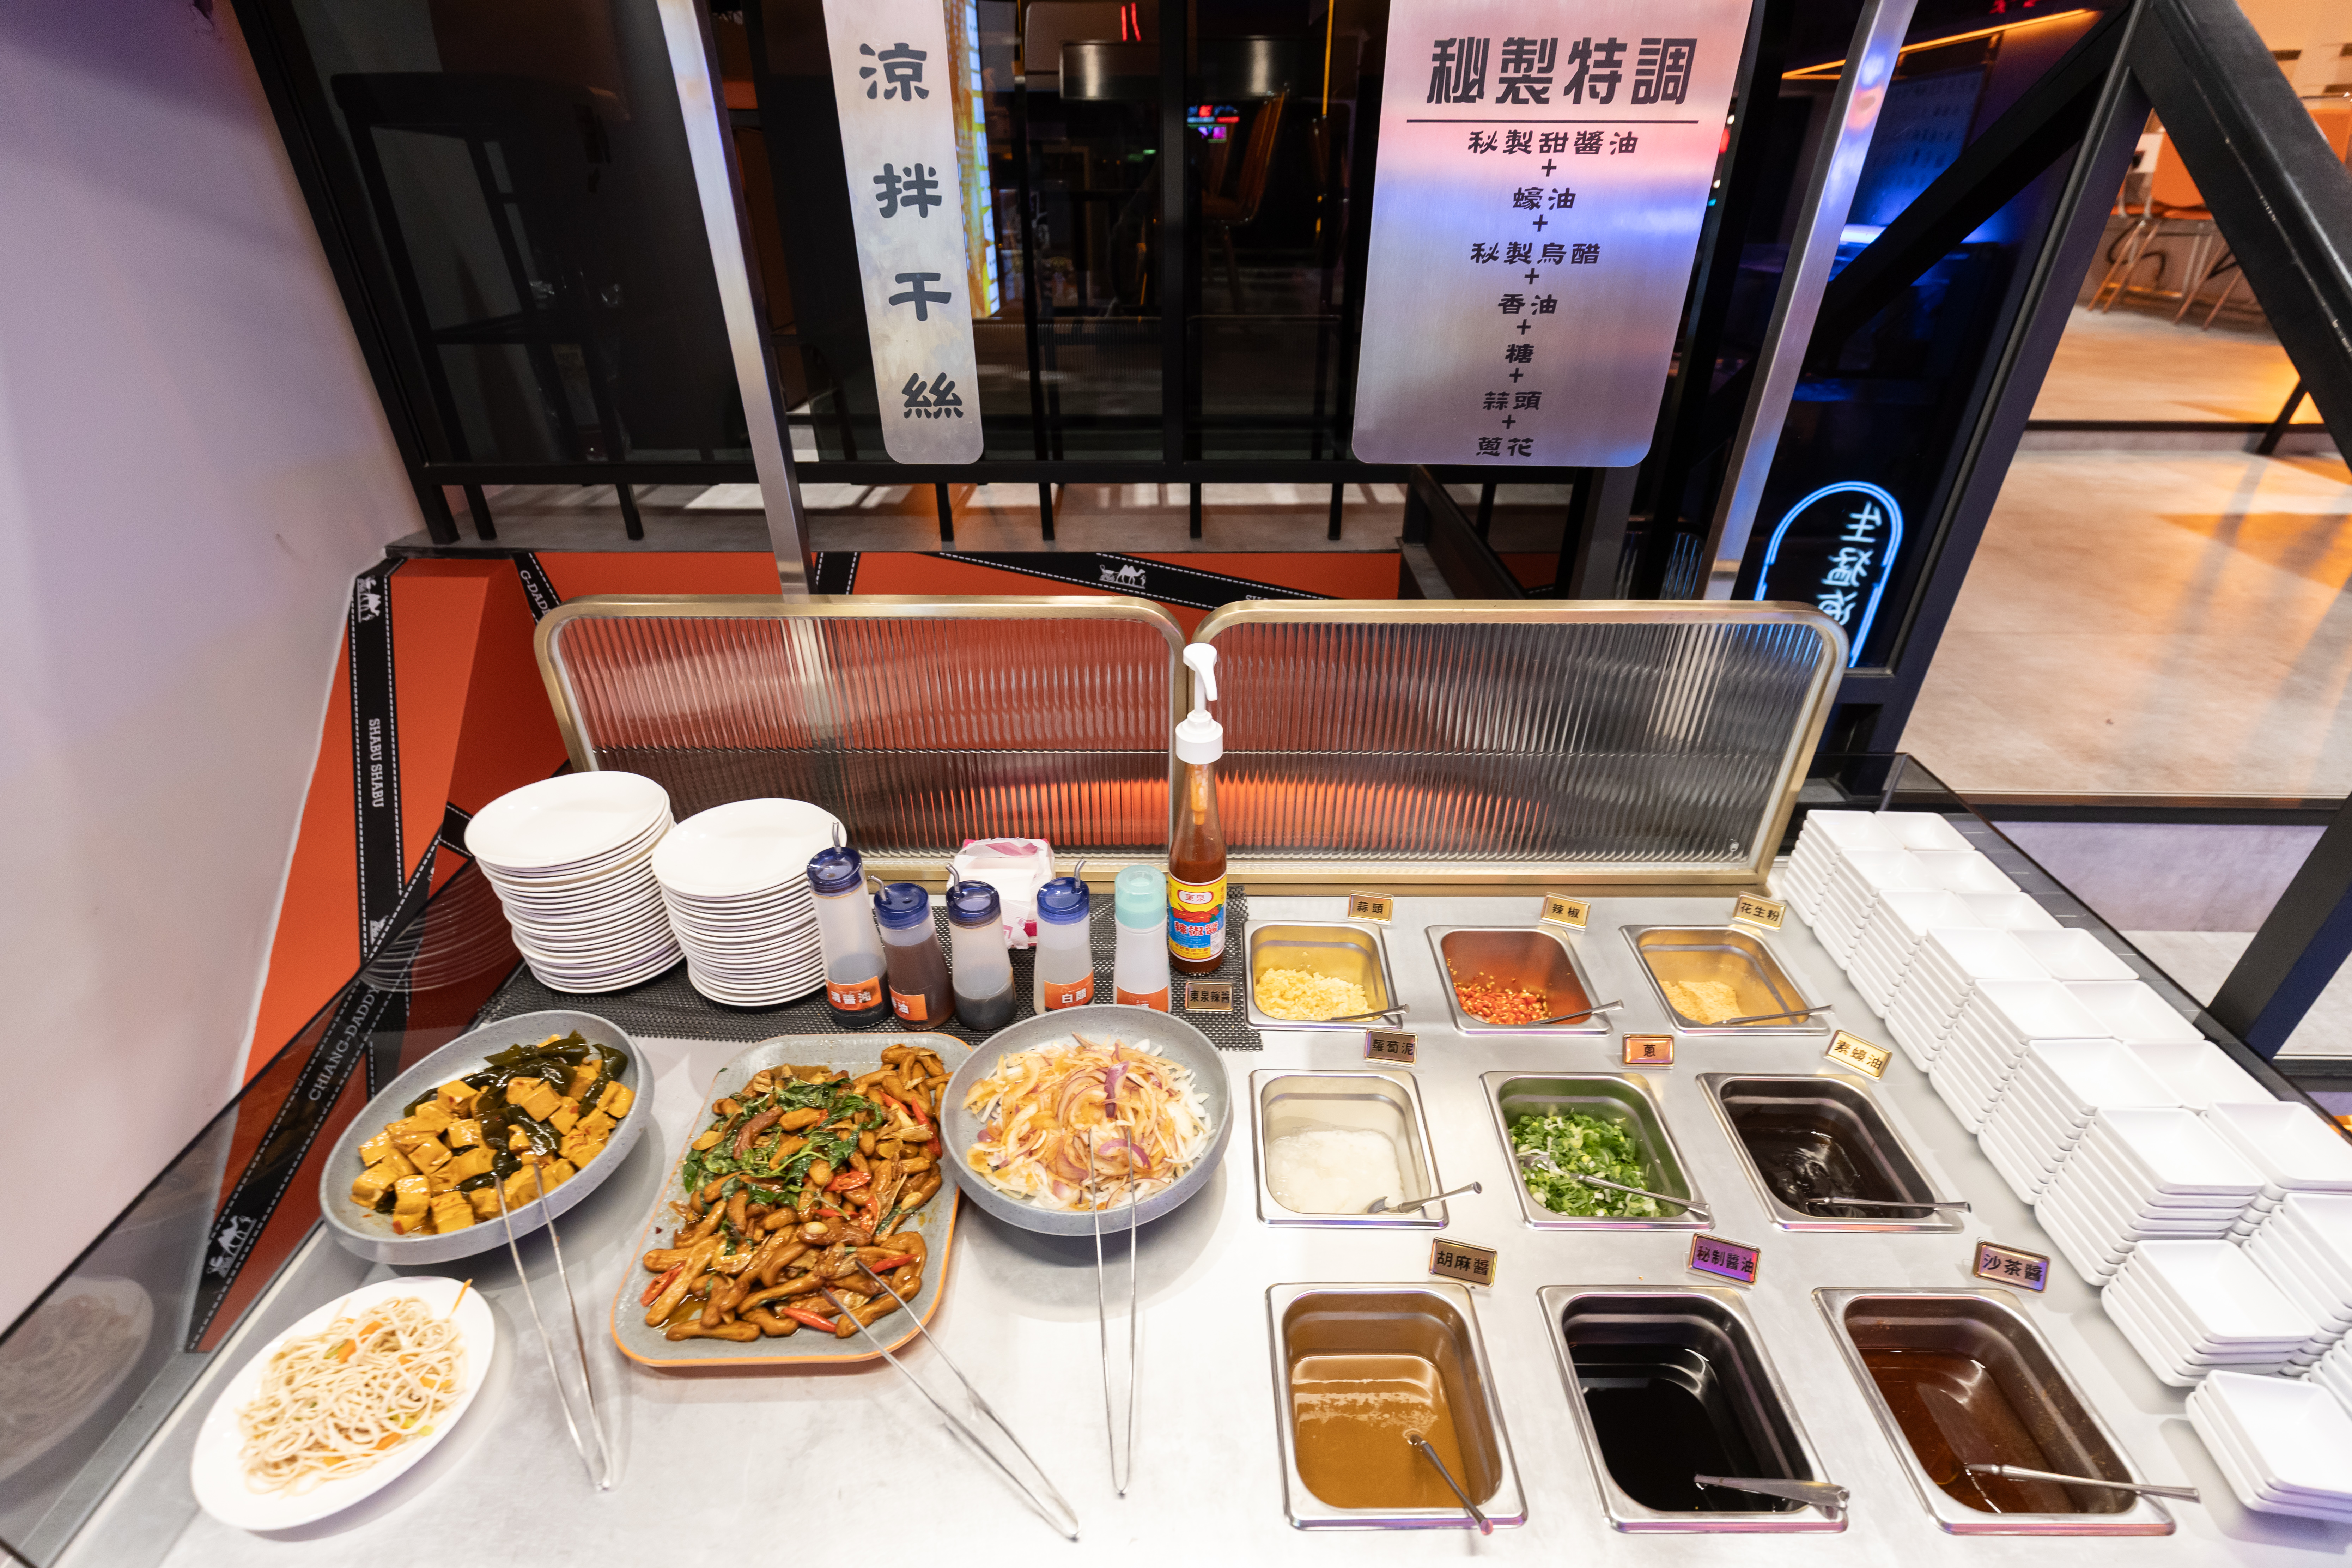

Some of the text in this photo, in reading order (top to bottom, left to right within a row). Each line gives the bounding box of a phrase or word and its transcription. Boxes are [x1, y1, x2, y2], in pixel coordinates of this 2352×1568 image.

[1427, 37, 1697, 105] 秘製特調
[1468, 129, 1639, 155] 秘製甜醬油
[1512, 187, 1576, 211] 蠔油
[859, 42, 964, 419] 涼拌干絲
[1470, 241, 1601, 265] 秘製烏醋
[1497, 294, 1558, 315] 香油
[1505, 343, 1534, 364] 糖
[1483, 391, 1543, 411] 蒜頭
[1476, 437, 1534, 457] 蔥花
[369, 718, 384, 808] SHABU SHABU
[1185, 893, 1205, 902] 東泉
[1357, 901, 1384, 914] 蒜頭
[1552, 903, 1580, 918] 辣椒
[1740, 902, 1780, 921] 花生粉
[1174, 921, 1218, 936] 辣椒醬
[1062, 988, 1086, 1003] 白醋
[1190, 990, 1230, 1003] 東泉辣醬
[308, 984, 380, 1101] CHIANG-DADDY
[1372, 1039, 1414, 1055] 蘿蔔泥
[1437, 1250, 1490, 1276] 胡麻醬
[1983, 1254, 2043, 1282] 沙茶醬
